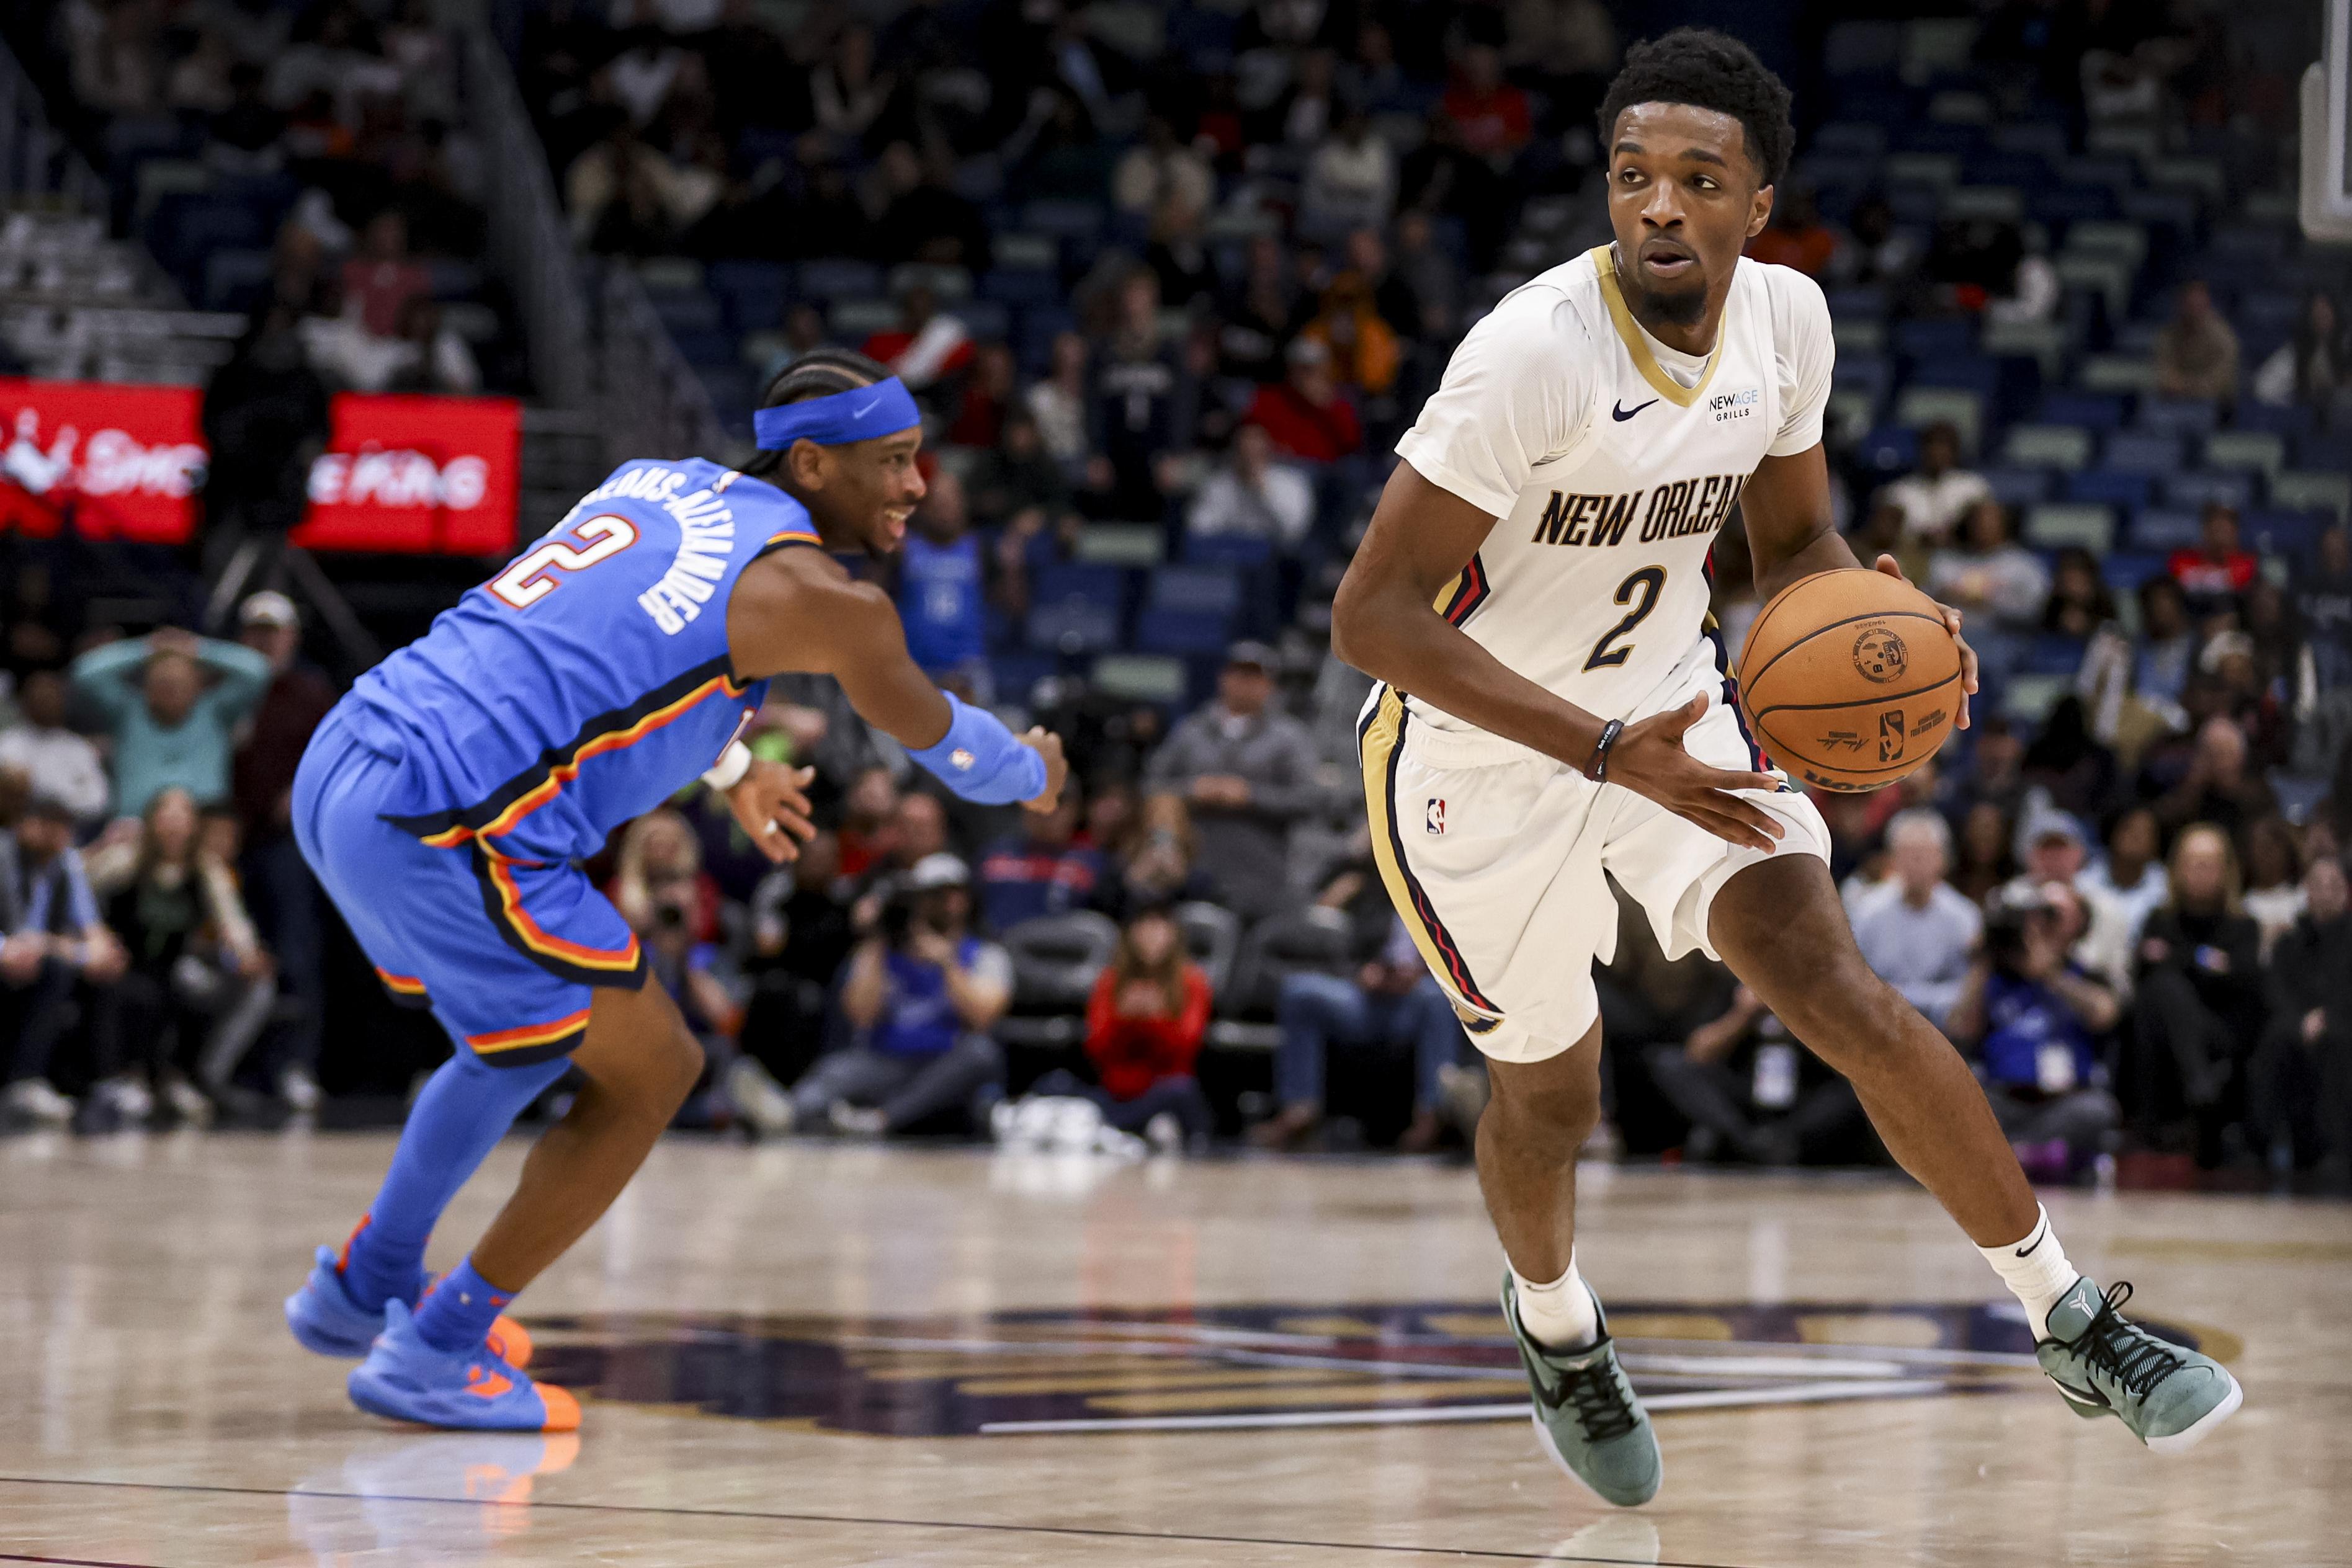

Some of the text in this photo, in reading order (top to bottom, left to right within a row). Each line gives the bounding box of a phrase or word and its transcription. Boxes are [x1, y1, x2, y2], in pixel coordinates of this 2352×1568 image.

[1716, 408, 1749, 421] GRILLS
[546, 466, 736, 636] EOUS-ALEXANDER
[1531, 473, 1751, 547] NEW ORLEAN
[485, 512, 641, 610] 2
[1581, 565, 1668, 674] 2
